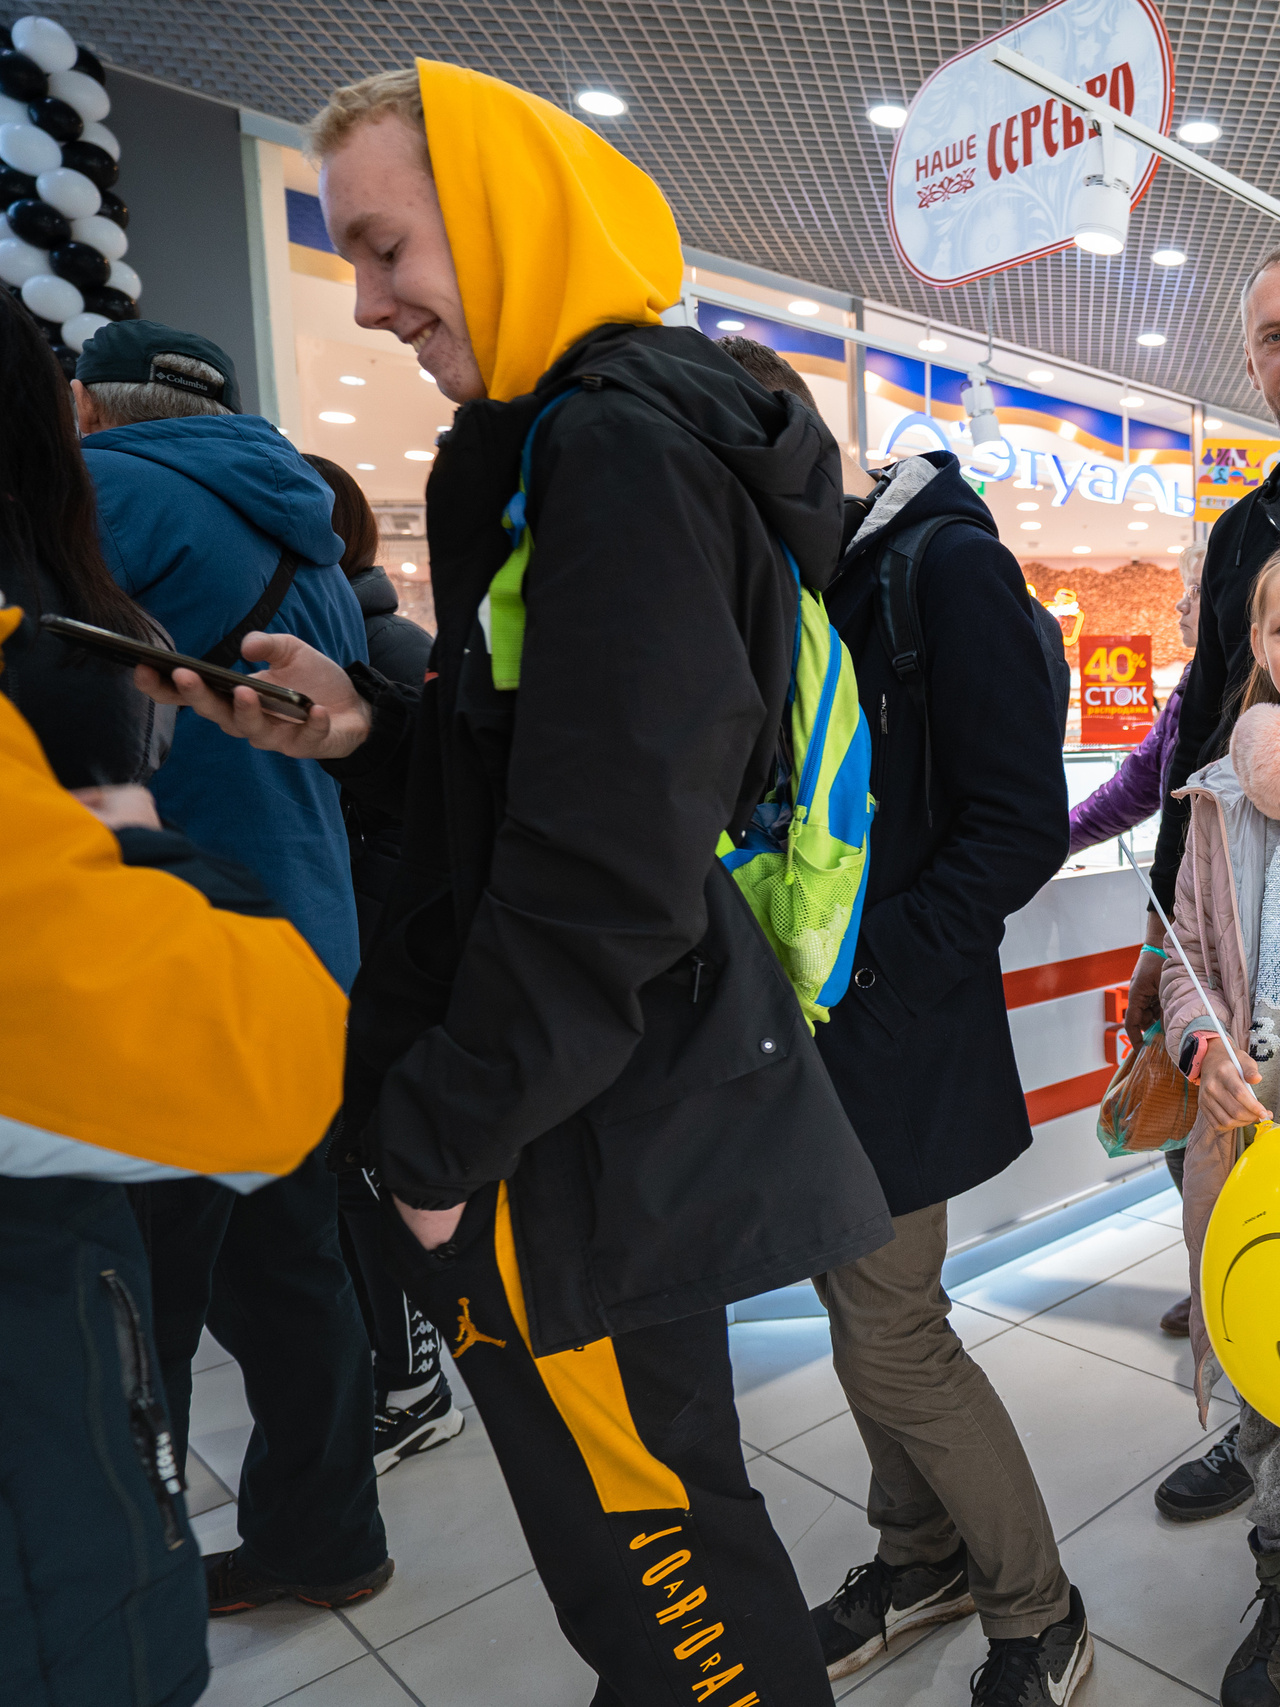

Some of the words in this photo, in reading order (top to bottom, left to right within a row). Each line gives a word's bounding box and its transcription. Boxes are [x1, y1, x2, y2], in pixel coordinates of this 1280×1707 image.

[915, 133, 977, 182] НАШЕ
[166, 373, 208, 391] Columbia
[1084, 686, 1148, 706] СТОК
[1087, 706, 1149, 716] распродажа
[629, 1525, 761, 1707] JORDA
